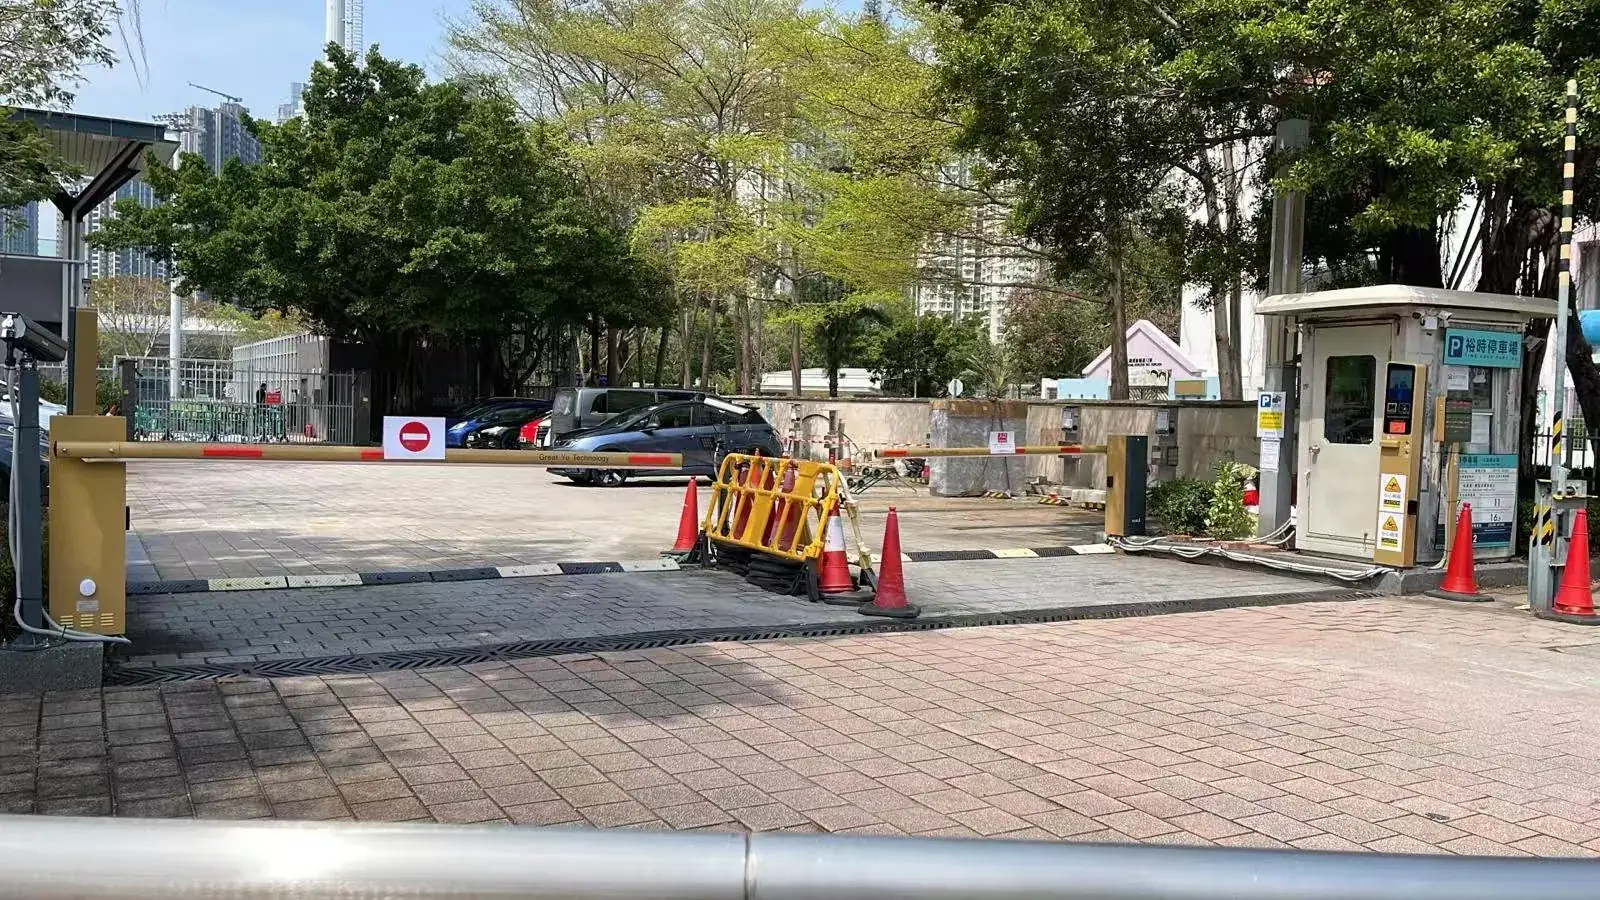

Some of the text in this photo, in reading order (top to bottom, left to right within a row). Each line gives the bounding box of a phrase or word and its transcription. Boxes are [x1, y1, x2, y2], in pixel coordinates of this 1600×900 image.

[1465, 337, 1518, 355] 裕時停車場
[539, 453, 609, 462] Great Yu Technology
